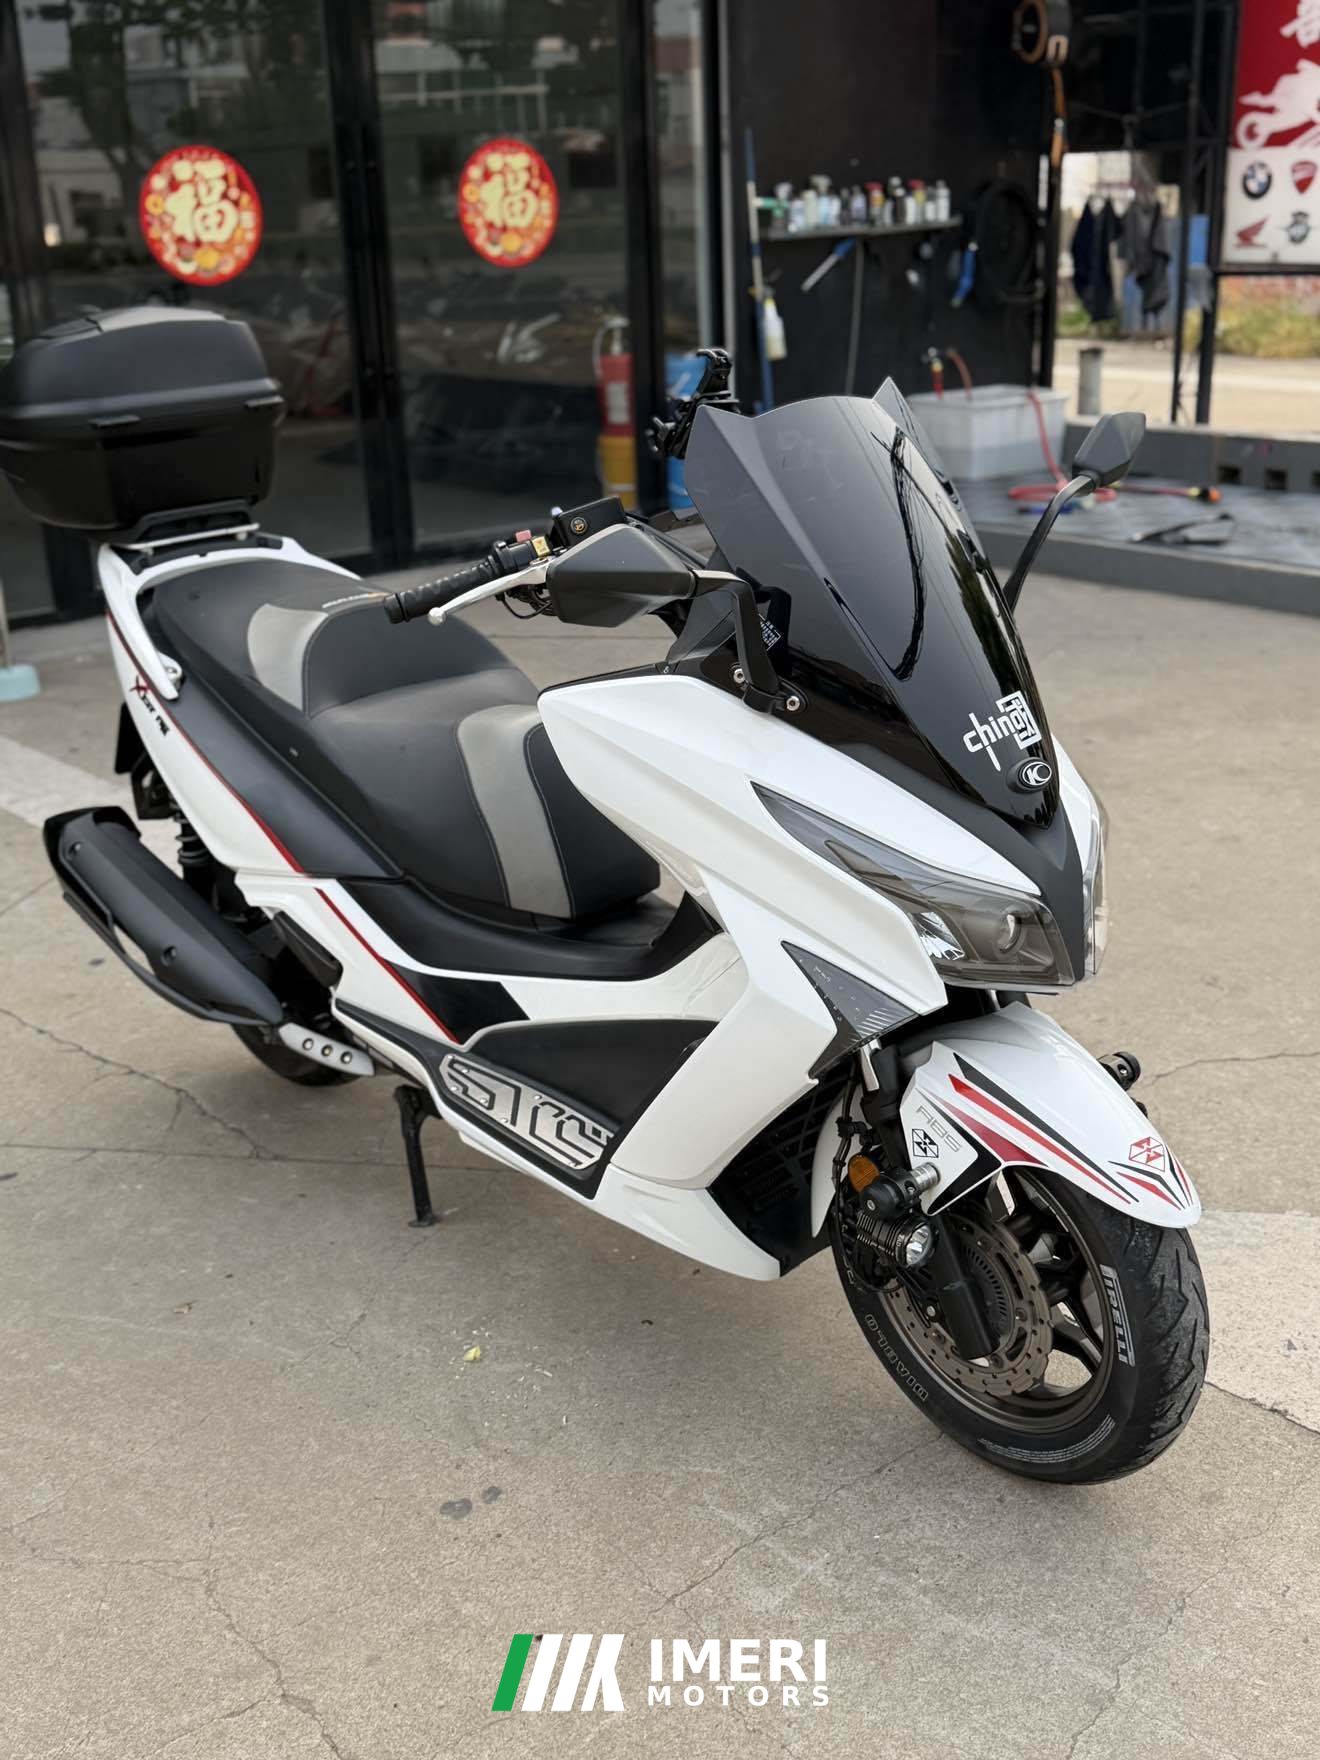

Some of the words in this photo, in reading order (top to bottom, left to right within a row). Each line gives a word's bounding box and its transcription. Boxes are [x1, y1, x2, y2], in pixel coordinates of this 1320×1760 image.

[165, 159, 239, 243] 福
[480, 152, 538, 228] 福
[864, 1313, 929, 1401] DIABLO
[1100, 1263, 1135, 1367] PIRELLI
